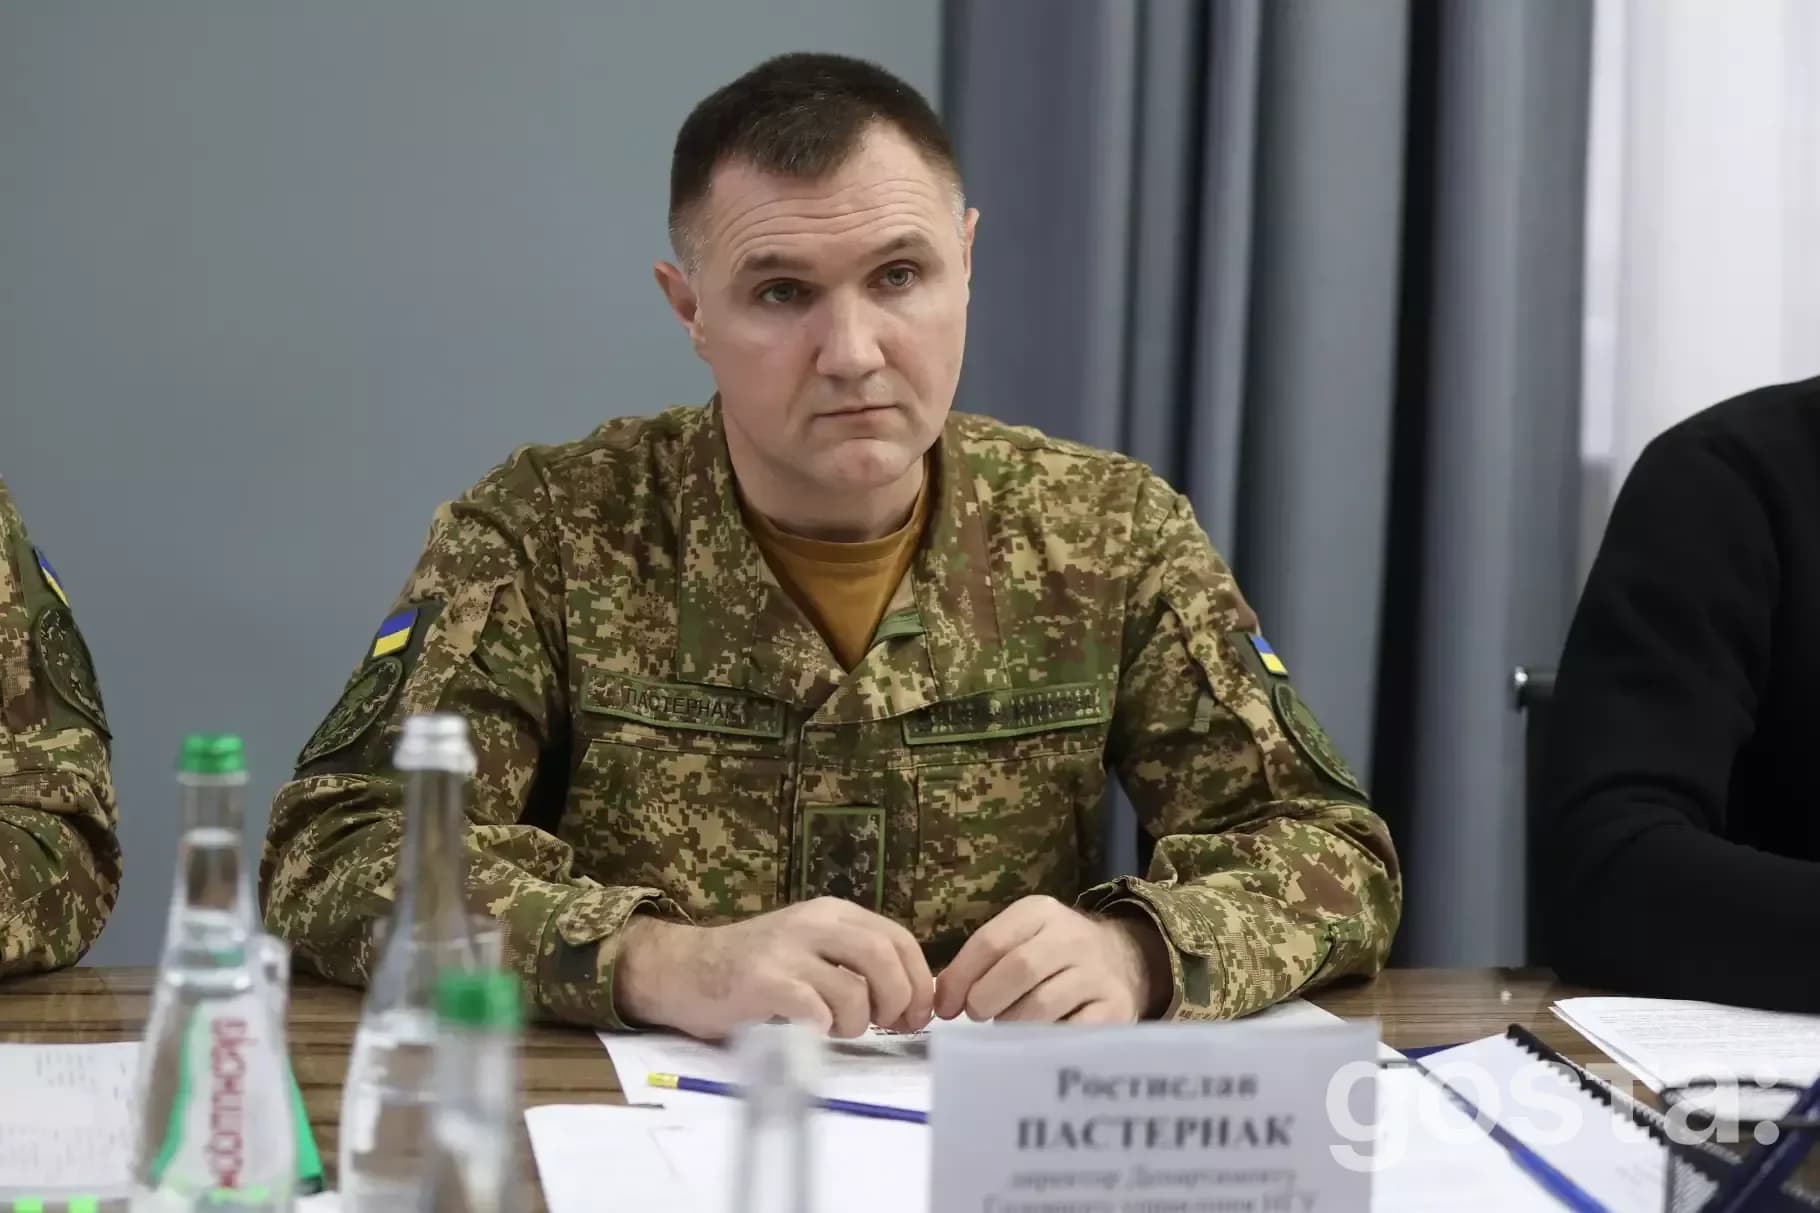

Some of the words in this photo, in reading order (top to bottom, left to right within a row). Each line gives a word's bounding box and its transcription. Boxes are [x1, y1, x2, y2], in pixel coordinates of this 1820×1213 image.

[622, 688, 740, 720] ПАСТЕРНАК
[1056, 1067, 1260, 1100] Ростислав
[1016, 1115, 1295, 1150] ПАСТЕРНАК
